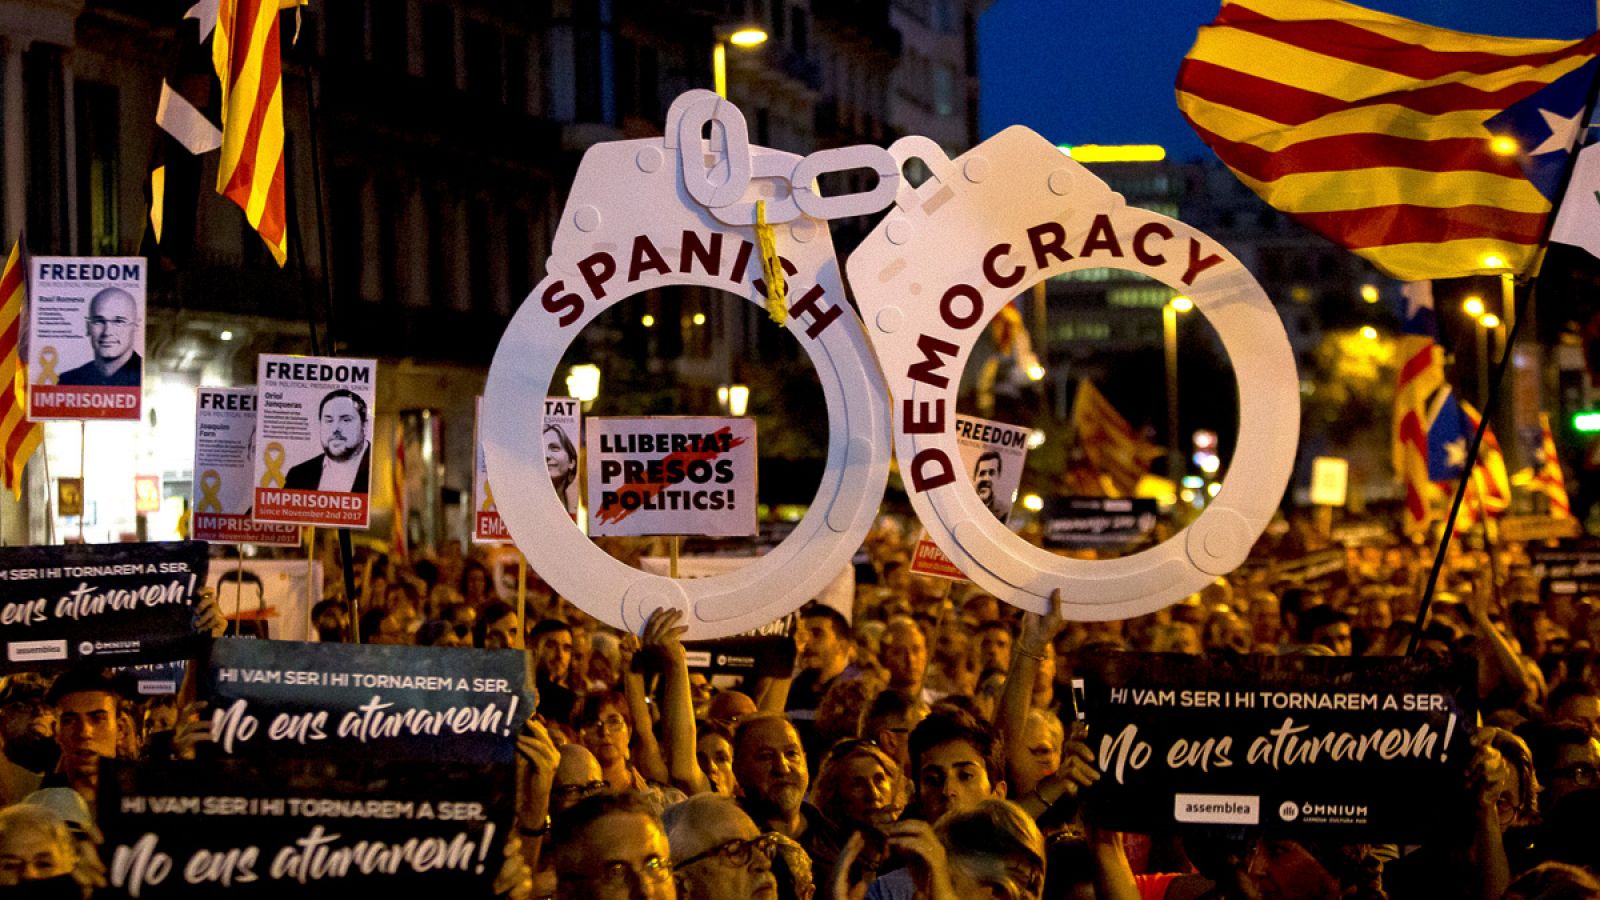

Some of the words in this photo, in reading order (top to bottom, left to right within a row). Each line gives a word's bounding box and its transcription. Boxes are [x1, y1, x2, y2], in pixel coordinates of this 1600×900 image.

[39, 263, 140, 281] FREEDOM
[541, 230, 844, 340] SPANISH
[903, 214, 1224, 493] DEMOCRACY
[265, 362, 370, 383] FREEDOM
[34, 391, 137, 409] IMPRISONED
[264, 392, 283, 400] Oriol
[264, 400, 302, 409] Junqueras
[600, 433, 733, 454] LLIBERTAT
[956, 420, 1027, 449] FREEDOM
[601, 460, 734, 485] PRESOS
[260, 491, 363, 510] IMPRISONED
[197, 516, 295, 533] IMPRISONED
[260, 508, 281, 516] since
[282, 509, 323, 519] November
[325, 511, 341, 519] 2nd
[342, 511, 362, 521] 2017
[10, 568, 37, 580] SER
[40, 568, 44, 579] I
[47, 567, 61, 579] HI
[64, 563, 144, 578] TORNAREM
[147, 563, 157, 574] A
[160, 562, 191, 573] SER.
[1, 598, 48, 626] ens
[54, 573, 197, 620] aturarem!
[219, 668, 239, 682] HI
[240, 669, 281, 684] VAM
[284, 671, 320, 685] SER
[322, 672, 328, 687] I
[330, 673, 349, 687] HI
[352, 673, 453, 691] TORNAREM
[456, 677, 469, 692] A
[473, 678, 512, 693] SER.
[1110, 687, 1129, 705] HI
[1132, 689, 1176, 707] VAM
[1180, 690, 1221, 708] SER
[1225, 691, 1230, 708] I
[1235, 692, 1255, 709] HI
[1259, 692, 1378, 711] TORNAREM
[1382, 693, 1398, 711] A
[1403, 693, 1449, 712] SER.
[210, 699, 259, 754] No
[268, 711, 329, 744] ens
[337, 695, 519, 743] aturarem!
[1098, 723, 1152, 784] No
[1167, 736, 1233, 772] ens
[1246, 712, 1456, 770] aturarem!
[121, 796, 147, 814] HI
[149, 796, 200, 815] VAM
[202, 796, 248, 815] SER
[250, 798, 258, 816] I
[260, 798, 285, 816] HI
[287, 798, 414, 819] TORNAREM
[416, 801, 435, 820] A
[437, 802, 487, 821] SER.
[1185, 801, 1251, 815] assemblea
[111, 832, 173, 898] No
[184, 845, 260, 888] ens
[269, 821, 496, 885] aturarem!
